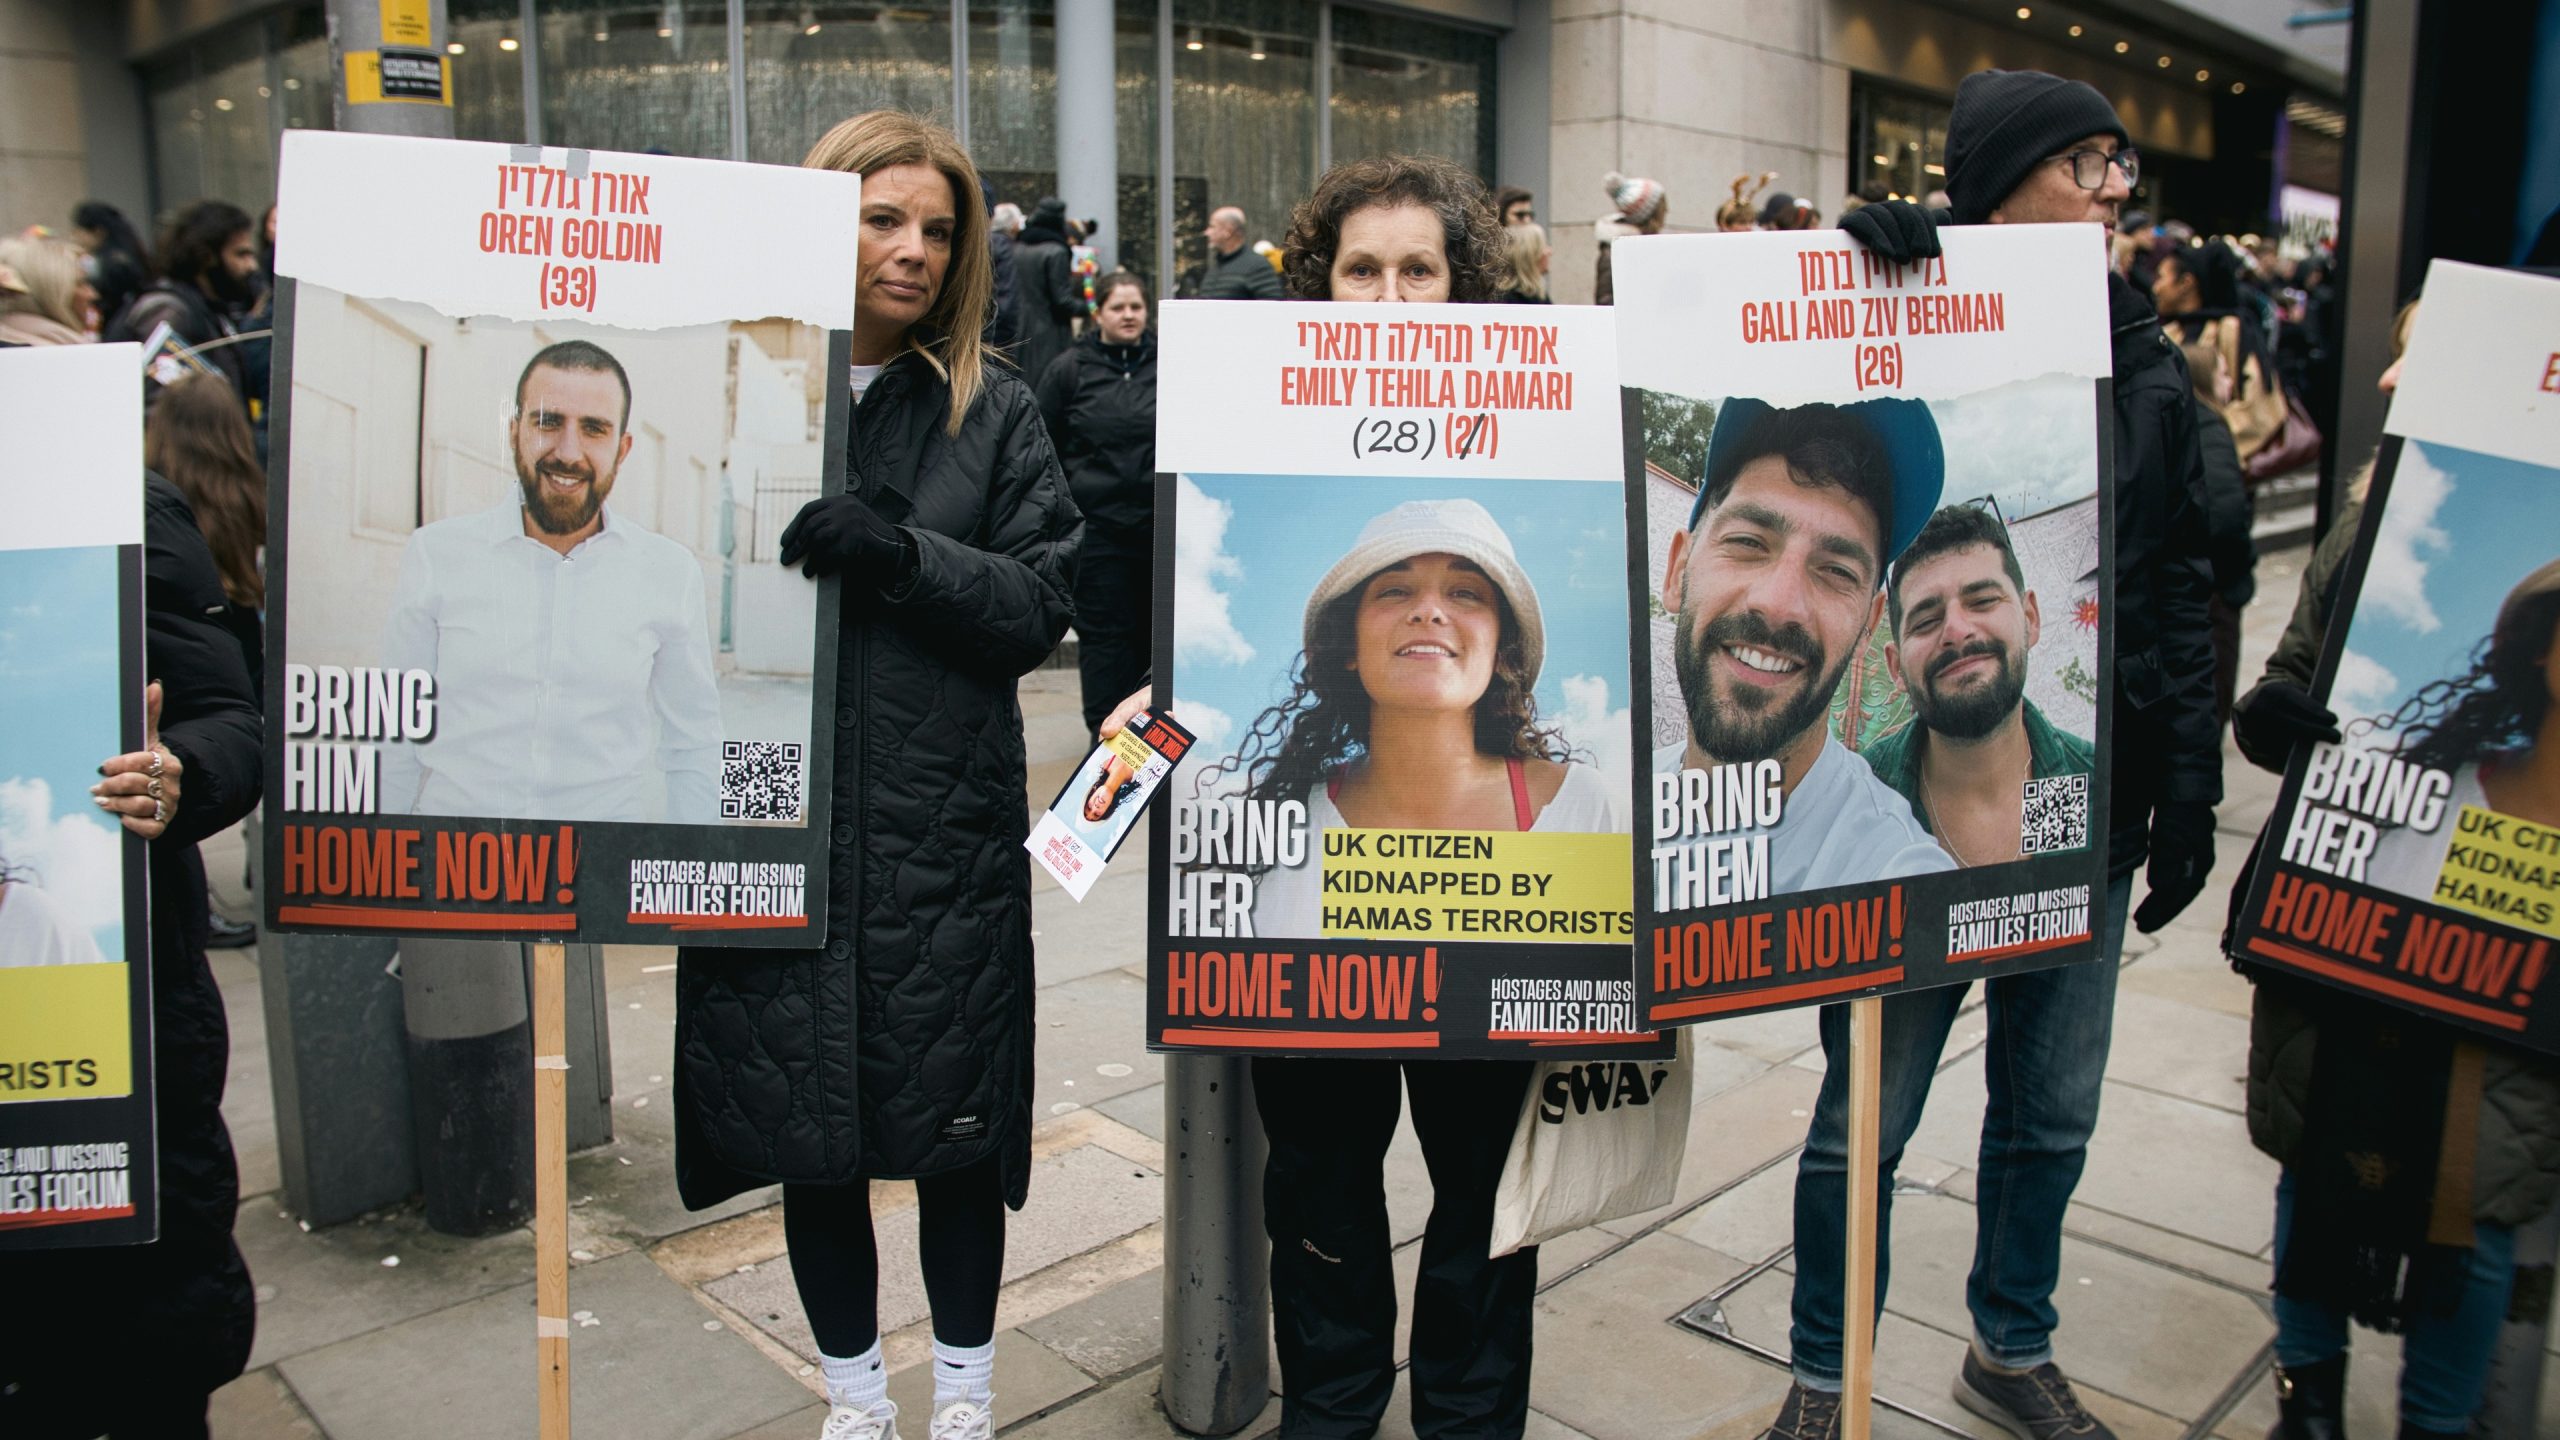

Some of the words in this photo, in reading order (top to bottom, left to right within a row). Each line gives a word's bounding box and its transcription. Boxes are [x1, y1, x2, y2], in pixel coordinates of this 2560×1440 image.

[592, 171, 650, 216] אורן
[479, 212, 554, 256] OREN
[562, 218, 662, 264] GOLDIN
[540, 262, 597, 312] (33)
[1797, 250, 1856, 297] ברמן
[1297, 321, 1379, 361] דמארי
[1741, 301, 1798, 343] GALI
[1805, 299, 1855, 340] AND
[1861, 296, 1899, 338] ZIV
[1906, 292, 2005, 336] BERMAN
[1387, 320, 1473, 364] תהילה
[1482, 322, 1559, 365] אמילי
[1281, 366, 1358, 407] EMILY
[1365, 368, 1457, 409] TEHILA
[1465, 369, 1573, 411] DAMARI
[1855, 341, 1903, 392] (26)
[1352, 416, 1437, 461] (28)
[284, 663, 434, 740] BRING
[1159, 736, 1184, 762] HOME
[283, 741, 377, 815] HIM
[1652, 758, 1782, 840] BRING
[2301, 741, 2453, 832] BRING
[1169, 799, 1307, 867] BRING
[1323, 832, 1367, 858] UK
[1376, 833, 1493, 860] CITIZEN
[2279, 801, 2379, 885] HER
[2458, 809, 2506, 842] UK
[284, 825, 421, 898] HOME
[435, 825, 578, 905] NOW!
[631, 859, 706, 884] HOSTAGES
[707, 861, 738, 885] AND
[740, 862, 806, 887] MISSING
[1323, 869, 1501, 896] KIDNAPPED
[1511, 873, 1553, 897] BY
[1651, 835, 1769, 914] THEM
[630, 882, 725, 917] FAMILIES
[730, 884, 805, 918] FORUM
[1168, 871, 1255, 938] HER
[1322, 906, 1433, 932] HAMAS
[1442, 908, 1634, 935] TERRORISTS
[1948, 899, 2010, 926] HOSTAGES
[2011, 893, 2036, 916] AND
[2037, 884, 2090, 912] MISSING
[2434, 874, 2555, 925] HAMAS
[1654, 912, 1773, 993] HOME
[1786, 884, 1904, 973] NOW!
[1948, 917, 2025, 957] FAMILIES
[2029, 908, 2089, 944] FORUM
[2259, 870, 2399, 965] HOME
[2395, 911, 2552, 1008] NOW!
[1167, 951, 1294, 1018] HOME
[1308, 946, 1441, 1022] NOW!
[1491, 978, 1562, 1001] HOSTAGES
[1564, 980, 1593, 1001] AND
[1595, 980, 1635, 1002] MISS
[1490, 1001, 1580, 1033] FAMILIES
[1585, 1002, 1654, 1034] FORU
[13, 1145, 51, 1174] AND
[51, 1141, 130, 1171] MISSING
[41, 1168, 131, 1213] FORUM
